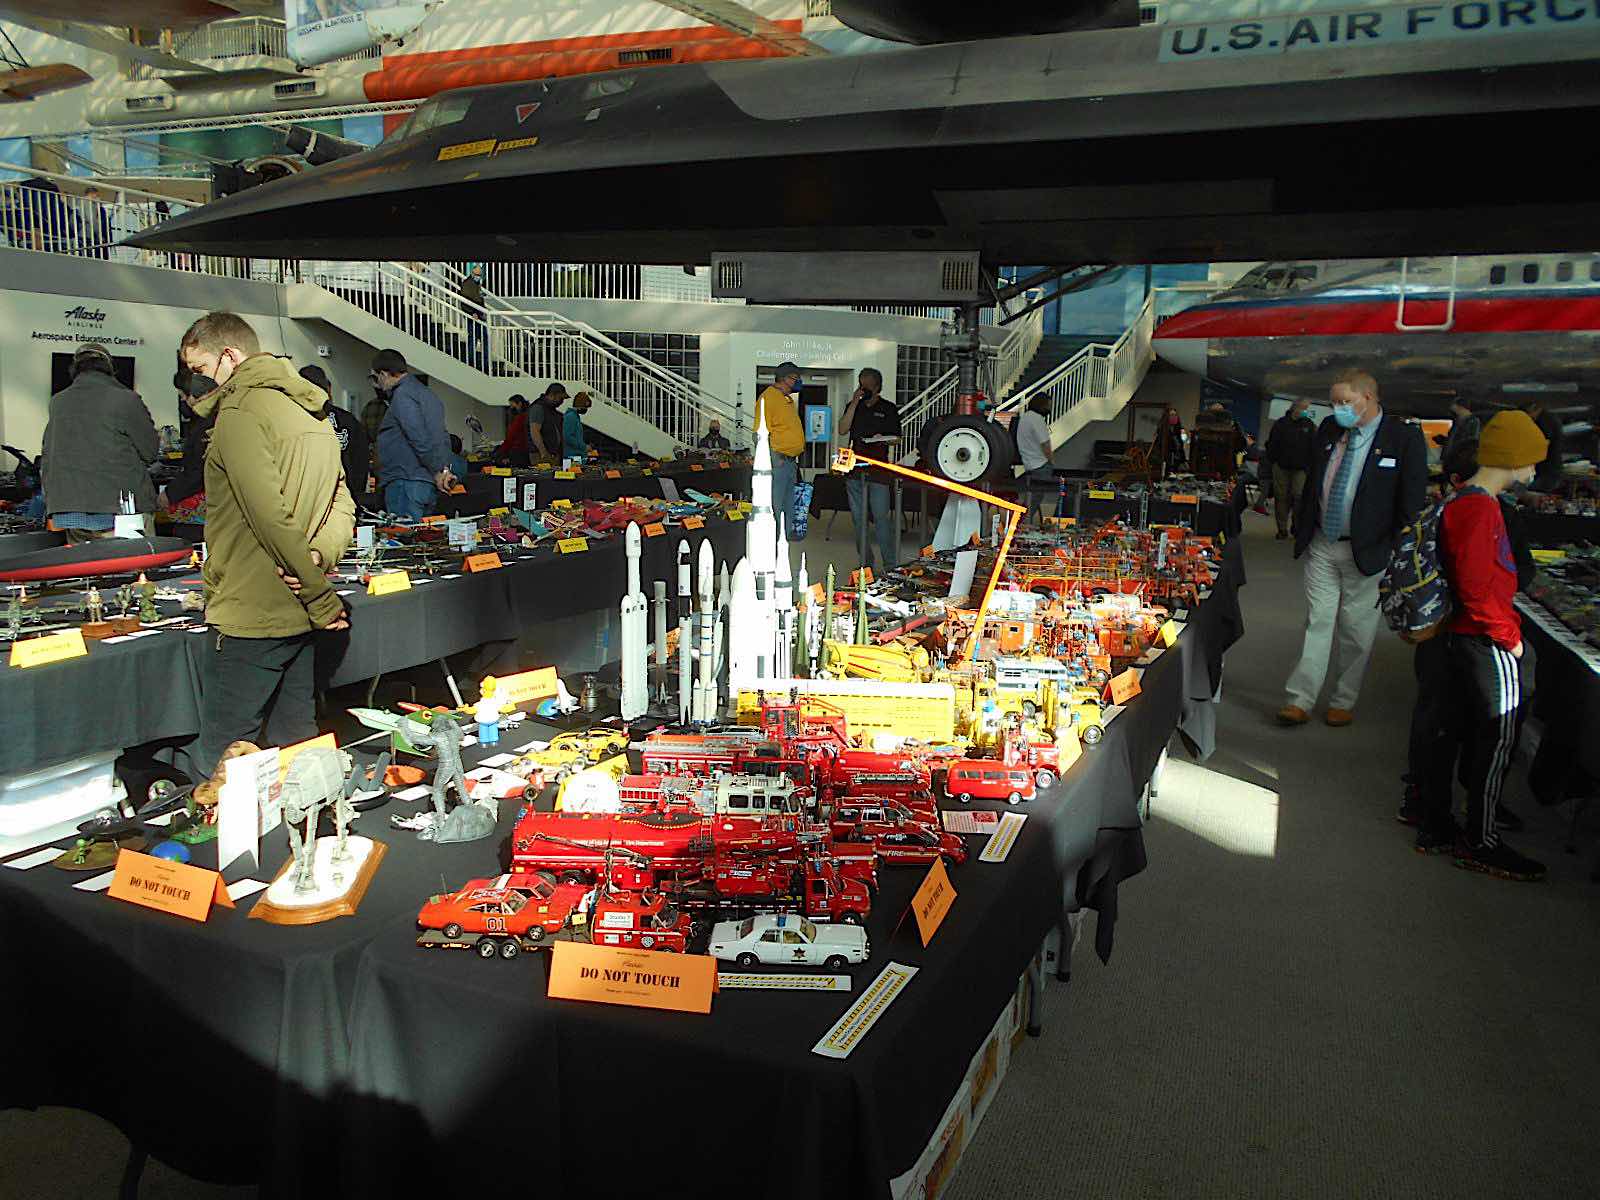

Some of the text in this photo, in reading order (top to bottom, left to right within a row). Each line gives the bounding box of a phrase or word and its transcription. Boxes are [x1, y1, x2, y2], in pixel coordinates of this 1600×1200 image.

[1406, 0, 1600, 35] FORC
[64, 305, 106, 321] Alaska
[67, 321, 103, 329] AIRLINES
[31, 331, 73, 342] Aerospace
[75, 333, 112, 345] Education
[113, 336, 137, 346] Center
[887, 849, 905, 857] FIRE
[129, 876, 142, 887] DO
[144, 880, 161, 893] NOT
[162, 884, 191, 901] TOUCH
[486, 917, 507, 931] 01
[580, 967, 680, 988] DO NOT TOUCH
